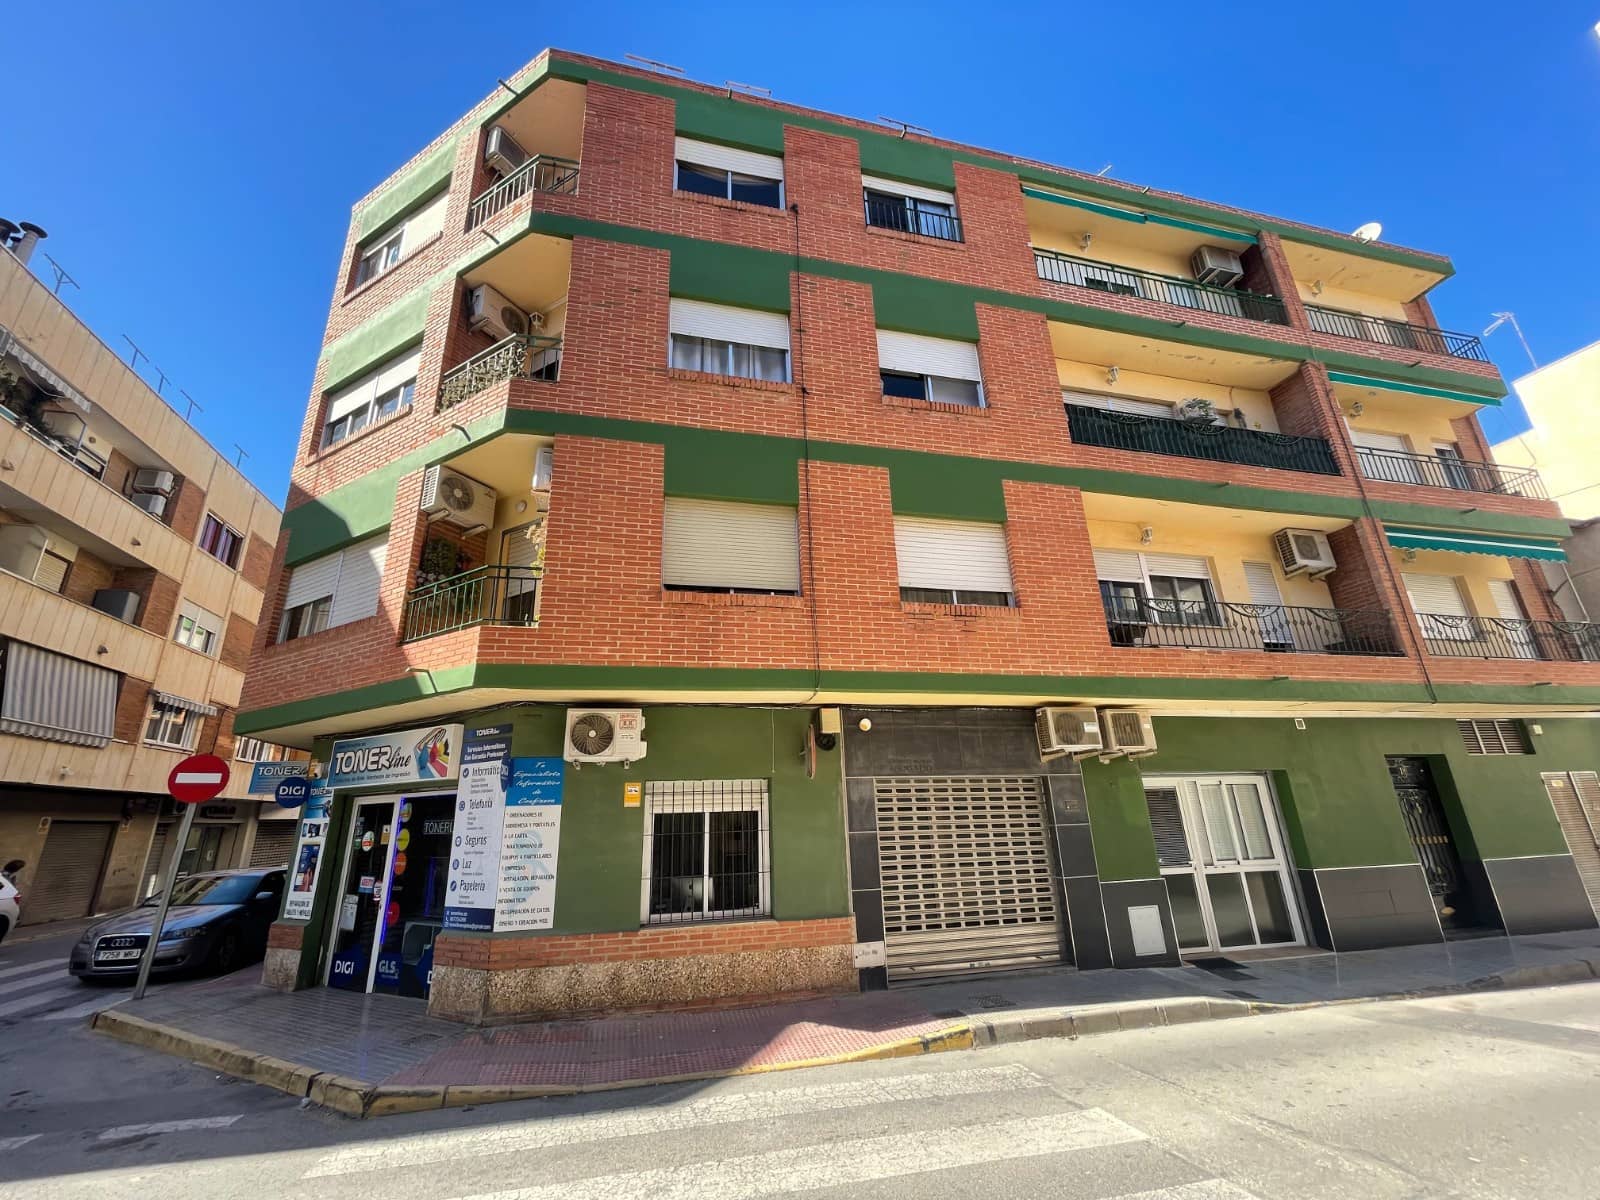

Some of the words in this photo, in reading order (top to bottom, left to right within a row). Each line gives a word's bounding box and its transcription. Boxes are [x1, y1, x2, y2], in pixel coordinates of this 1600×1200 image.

[279, 785, 306, 796] DIGI
[334, 960, 355, 975] DIGI
[378, 960, 397, 974] GLS
